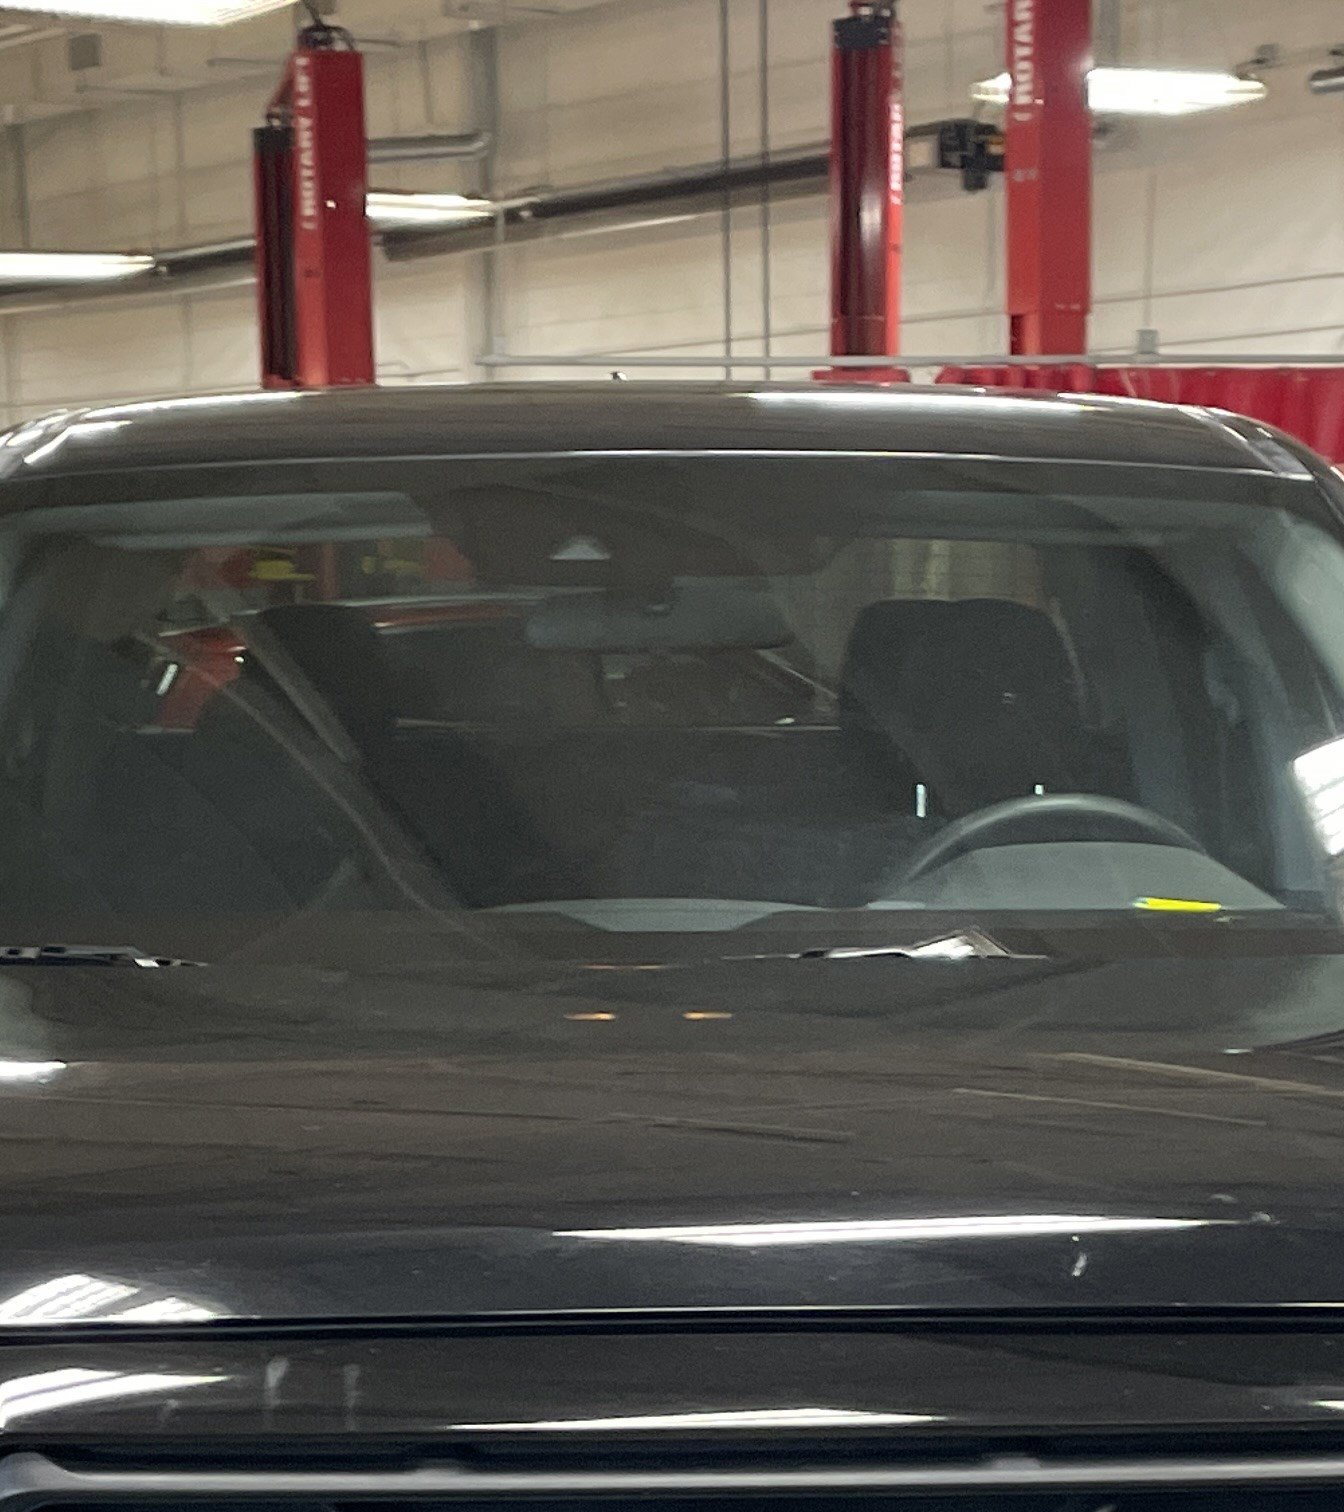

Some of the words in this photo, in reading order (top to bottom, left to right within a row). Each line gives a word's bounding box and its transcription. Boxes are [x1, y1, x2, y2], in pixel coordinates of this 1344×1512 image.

[295, 56, 312, 107] LIFT
[297, 117, 317, 217] ROTARY
[889, 92, 904, 191] ROTAR
